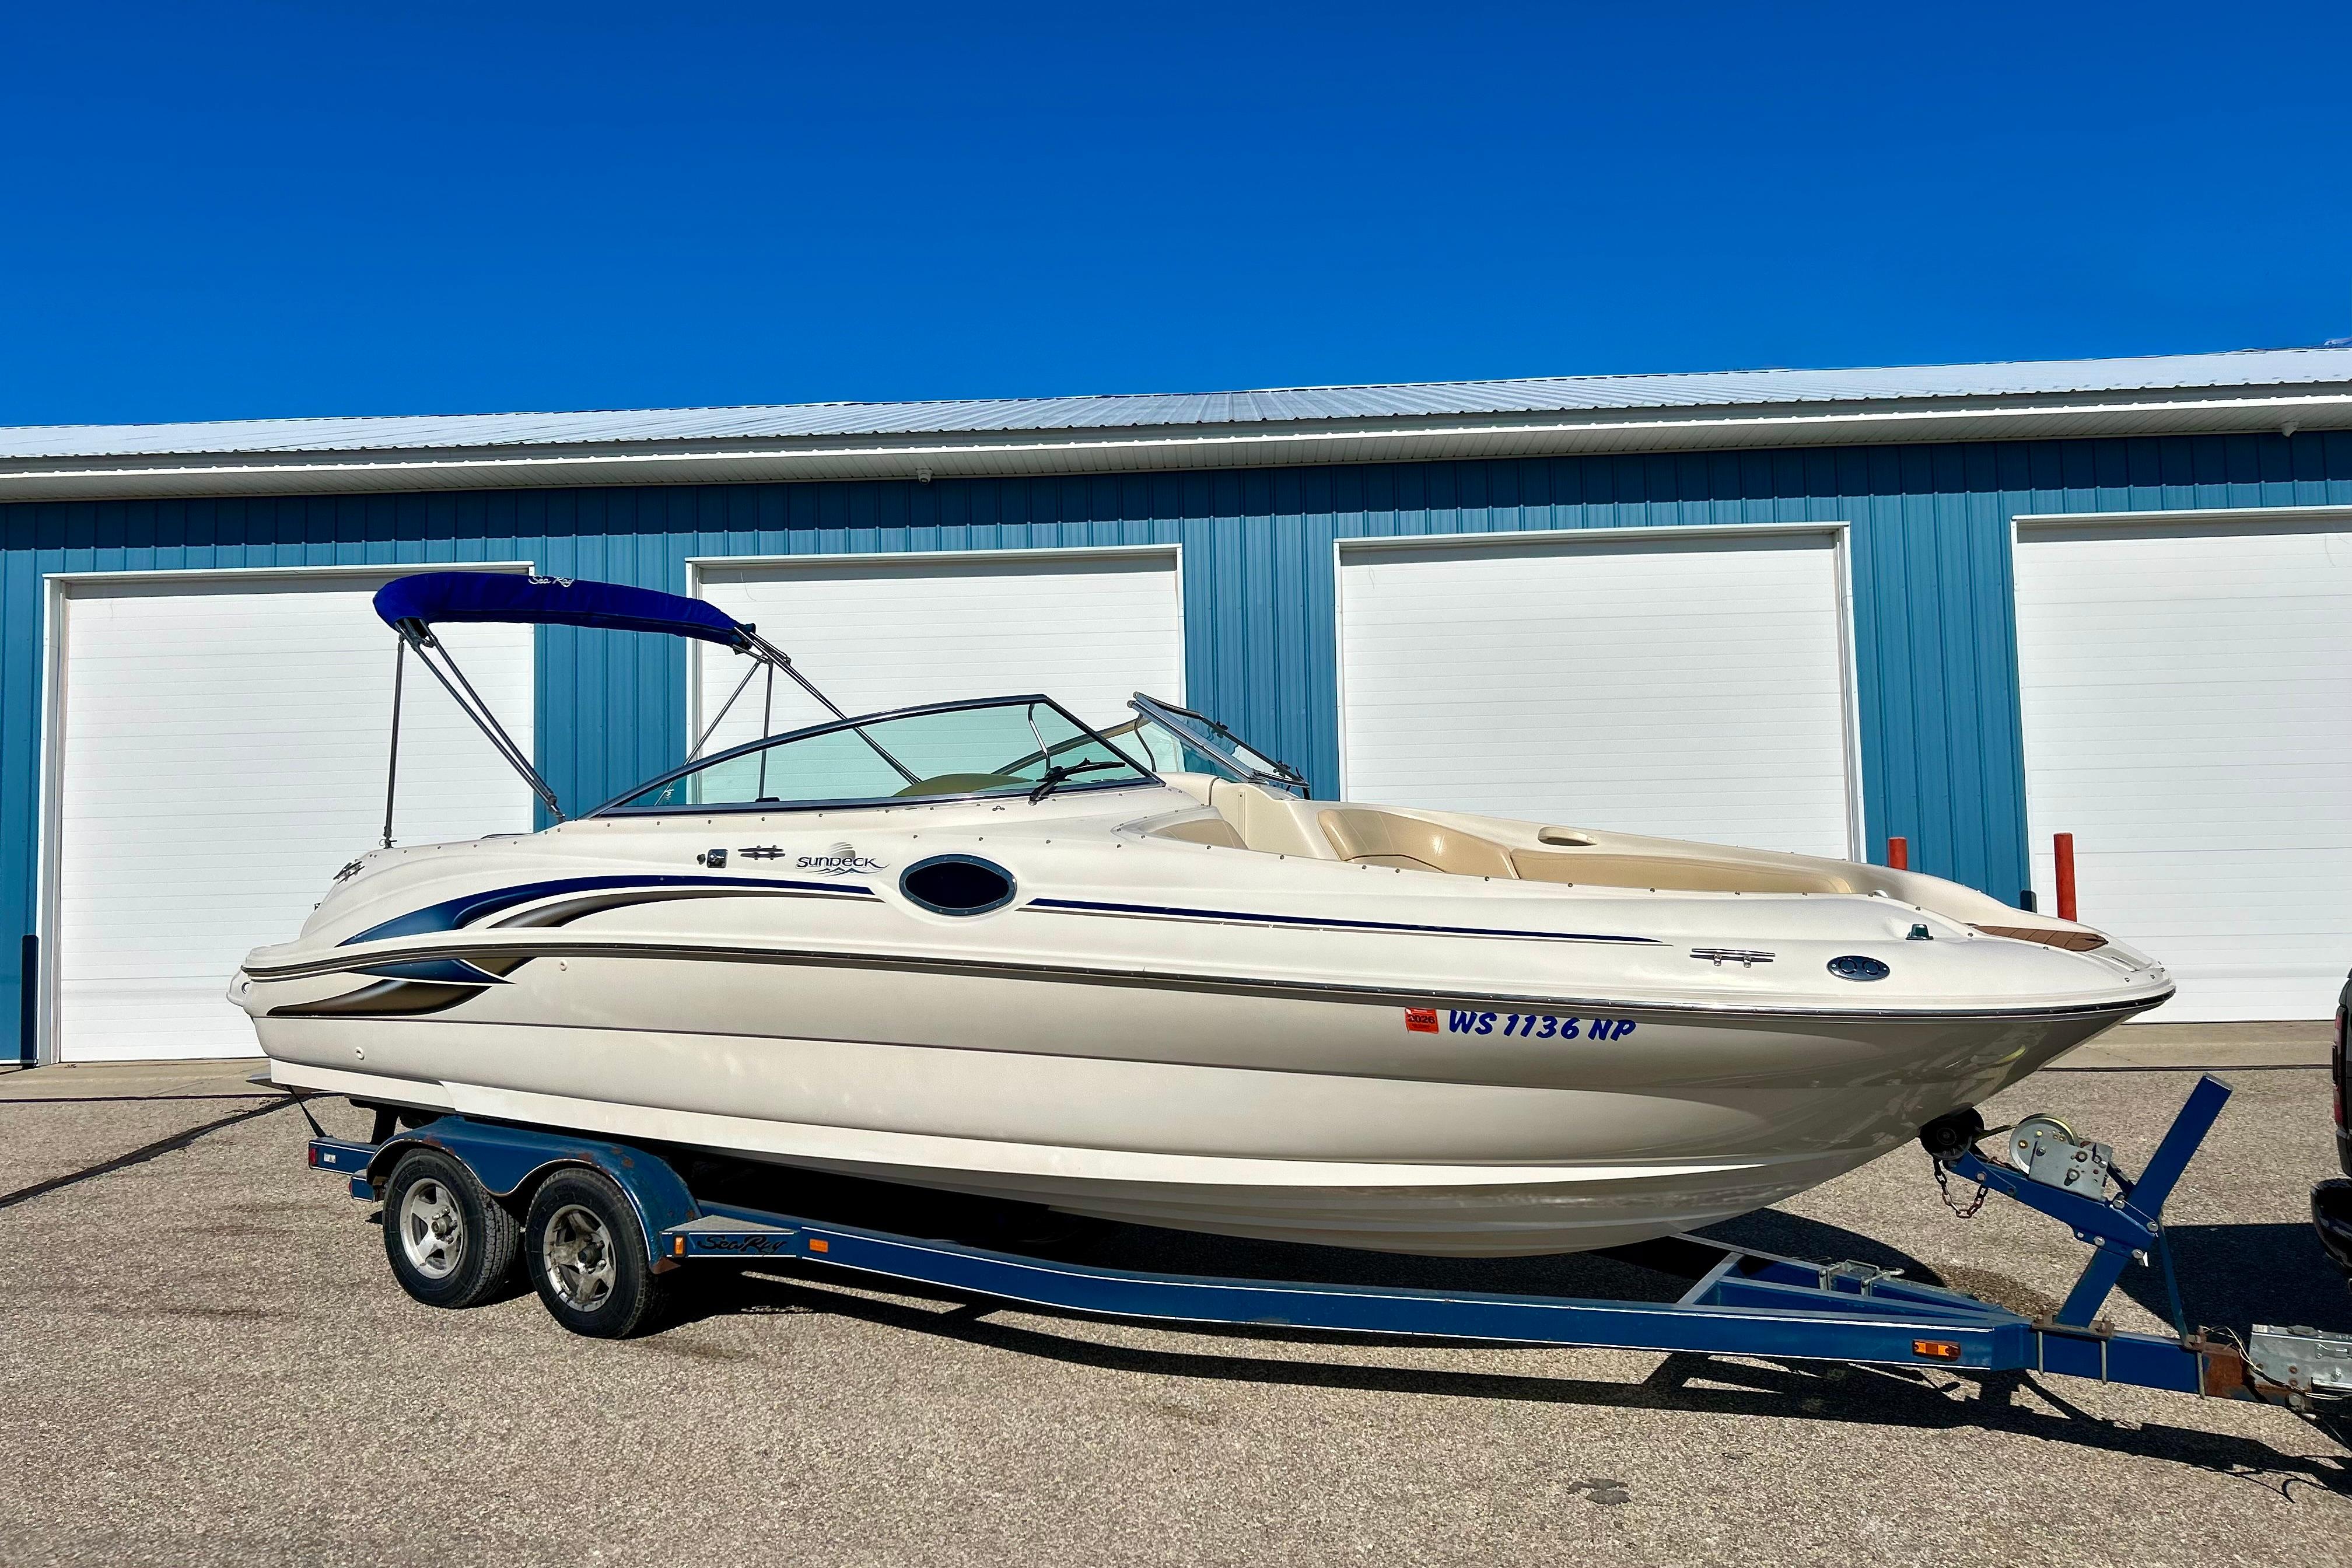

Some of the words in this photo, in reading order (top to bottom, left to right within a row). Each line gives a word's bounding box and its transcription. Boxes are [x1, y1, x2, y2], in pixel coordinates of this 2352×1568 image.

[528, 575, 551, 584] Sea
[552, 576, 575, 587] Ray
[1408, 1014, 1436, 1024] 2026
[1449, 1009, 1498, 1035] WS
[1503, 1013, 1581, 1040] 1136
[1587, 1017, 1637, 1042] NP
